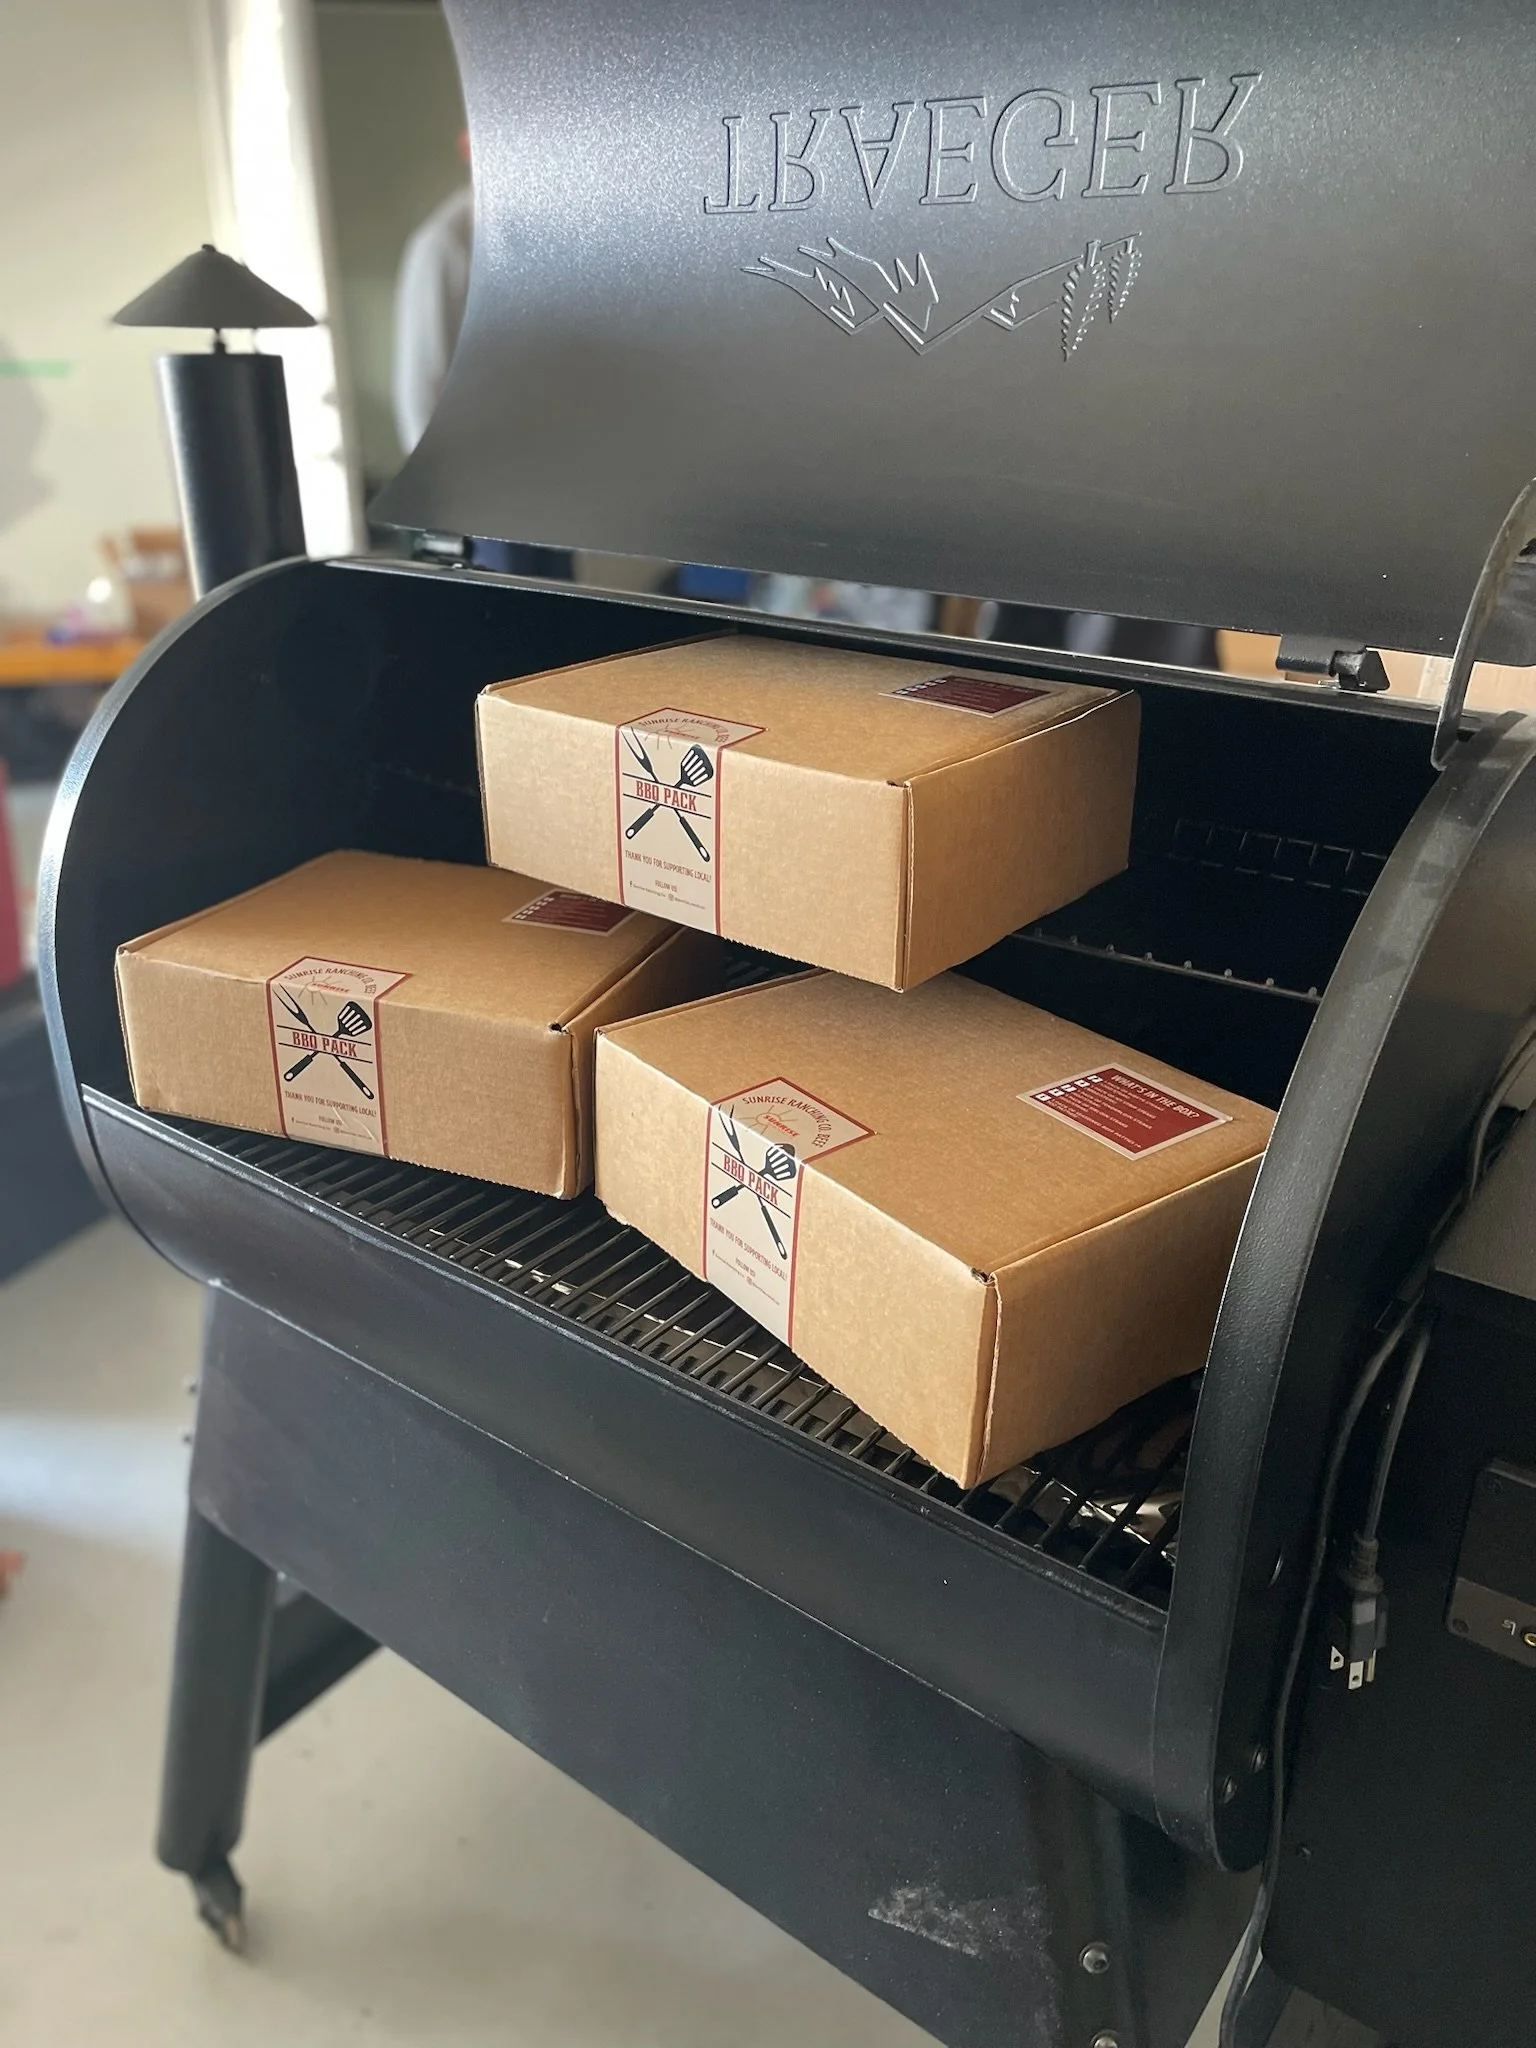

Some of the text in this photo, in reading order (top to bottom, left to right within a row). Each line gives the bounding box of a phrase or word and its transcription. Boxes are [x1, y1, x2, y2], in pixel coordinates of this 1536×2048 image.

[636, 780, 697, 812] BBQ PACK
[625, 850, 642, 862] THANK
[642, 854, 653, 865] YOU
[653, 858, 663, 869] FOR
[663, 861, 694, 878] SUPPORTING
[292, 1031, 358, 1058] BBQ PACK
[304, 1094, 315, 1104] YOU
[315, 1097, 326, 1107] FOR
[326, 1100, 359, 1114] SUPPORTING
[742, 1095, 788, 1105] SUNRISE
[787, 1098, 830, 1124] RANCHING
[1111, 1074, 1148, 1094] WHAT'S
[1143, 1090, 1159, 1099] IN
[1155, 1096, 1177, 1108] THE
[1172, 1104, 1200, 1119] BOX?
[763, 1114, 800, 1137] SUNRISE
[723, 1153, 779, 1206] BBQ PACK
[725, 1229, 735, 1242] YOU
[735, 1235, 744, 1248] FOR
[743, 1242, 771, 1270] SUPPORTING
